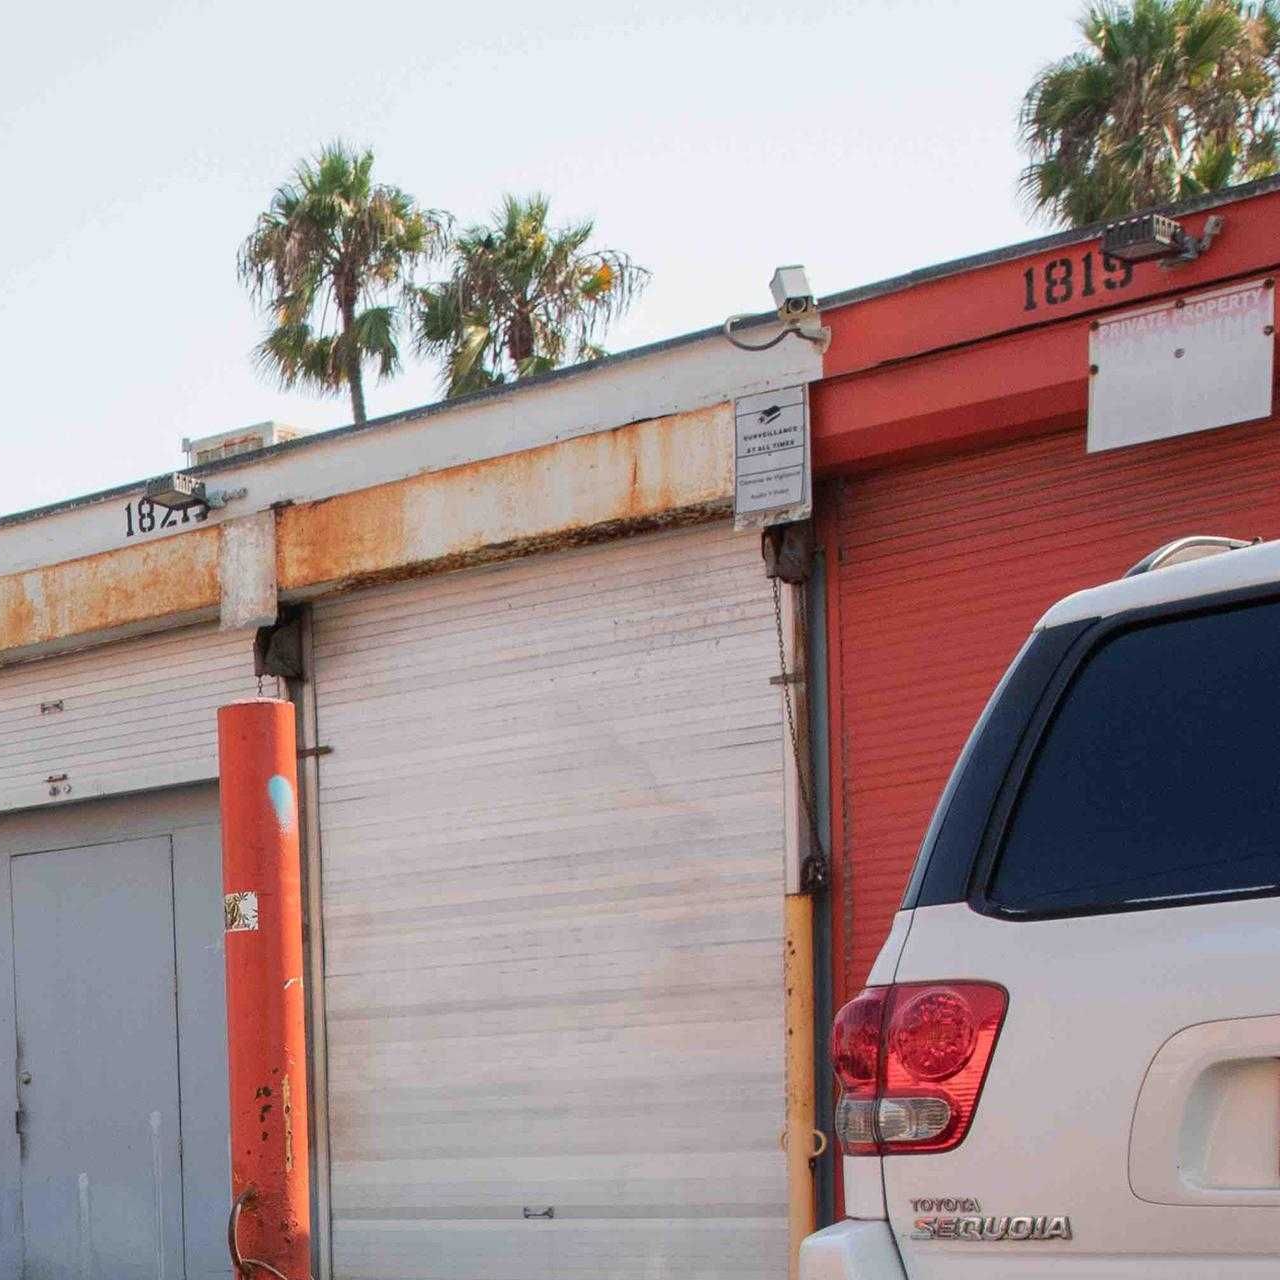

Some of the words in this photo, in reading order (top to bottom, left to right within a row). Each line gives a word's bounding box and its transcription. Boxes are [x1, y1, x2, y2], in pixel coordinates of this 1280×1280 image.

[1098, 311, 1169, 341] PRIVATE
[743, 426, 798, 441] SURVEILLANCE
[911, 1197, 982, 1213] TOYOTA
[910, 1216, 1073, 1241] SEQUOIA
